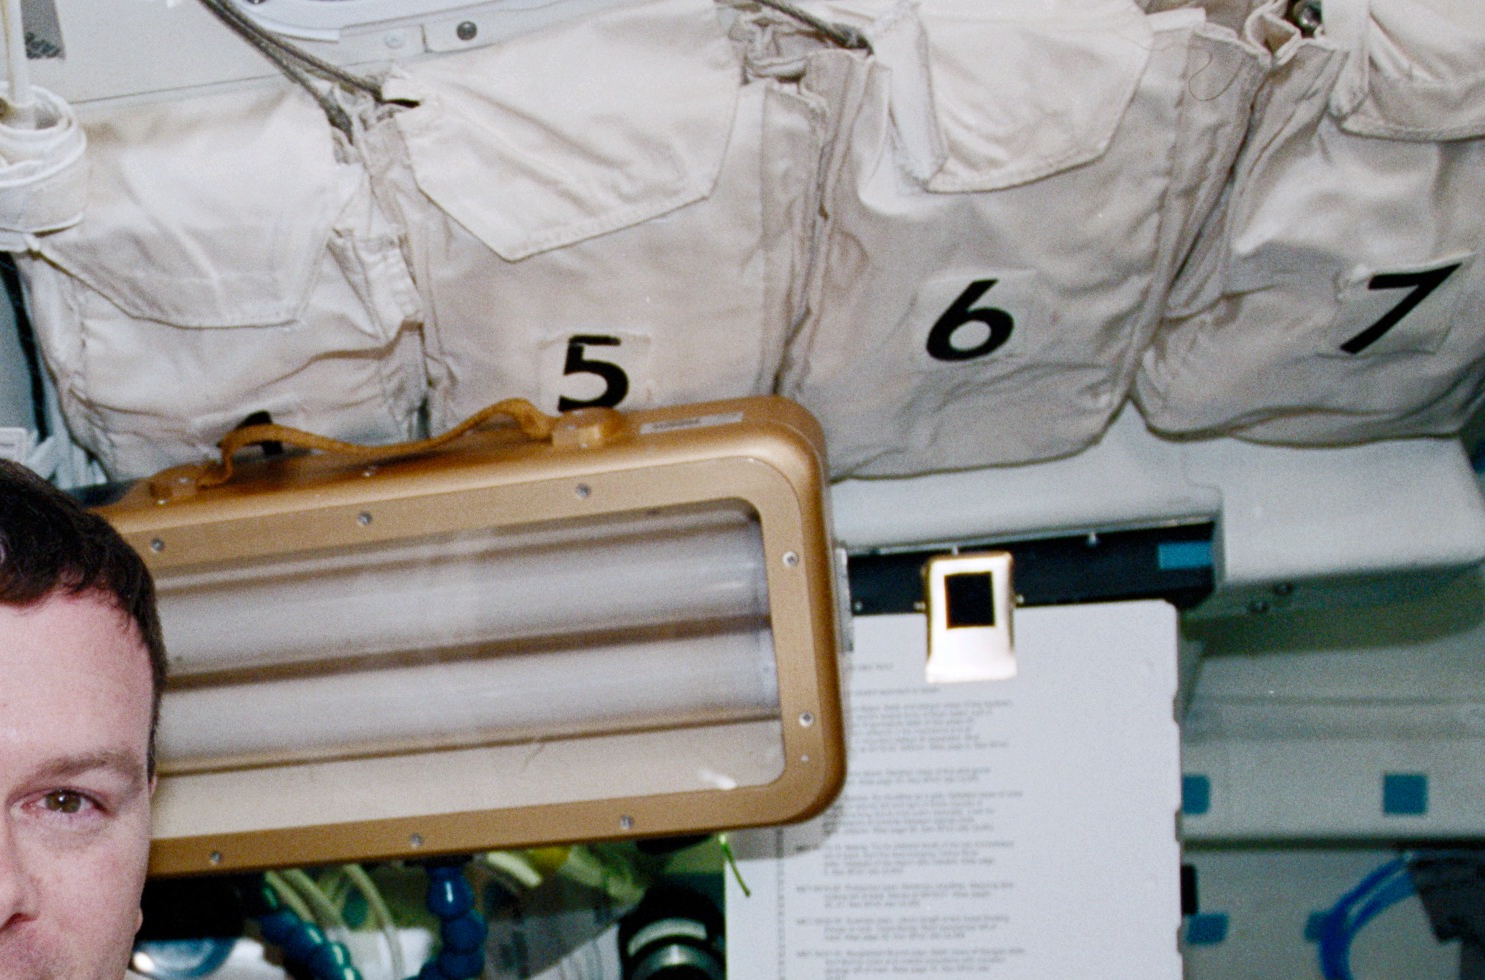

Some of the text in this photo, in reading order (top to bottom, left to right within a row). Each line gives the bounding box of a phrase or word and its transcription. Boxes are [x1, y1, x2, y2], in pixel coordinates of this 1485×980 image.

[926, 279, 1014, 362] 6
[1340, 262, 1463, 356] 7
[557, 334, 630, 419] 5
